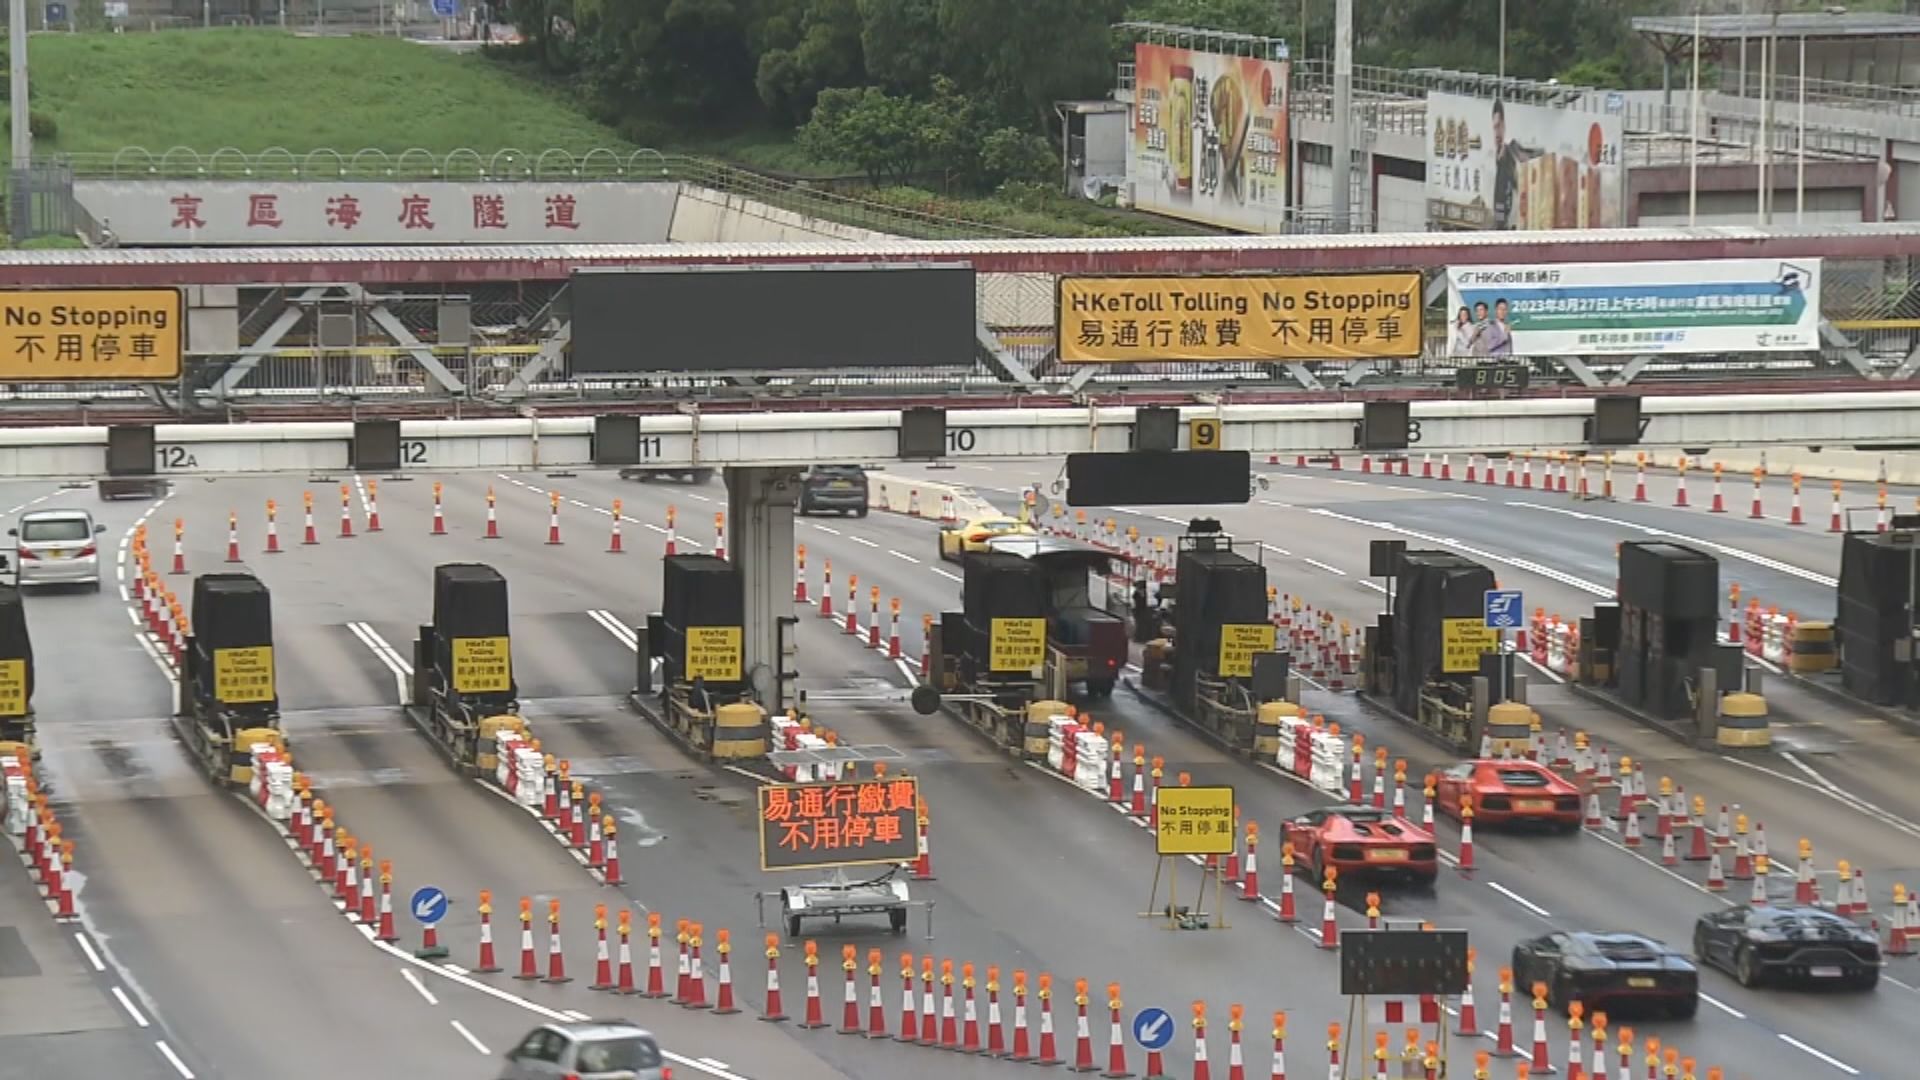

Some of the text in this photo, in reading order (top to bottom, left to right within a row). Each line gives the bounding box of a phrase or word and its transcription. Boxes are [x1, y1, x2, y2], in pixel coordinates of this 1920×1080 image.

[170, 193, 580, 229] 東區海底隧道
[1475, 272, 1523, 283] HKeToll
[1072, 290, 1411, 314] HKeToll Tolling No Stopping
[5, 305, 167, 330] No Stopping
[1077, 316, 1402, 348] 易通行繳費 不用停車
[14, 333, 159, 363] 不用停車
[946, 429, 976, 452] 10
[1197, 424, 1215, 446] 9
[157, 447, 198, 470] 12A
[401, 442, 427, 464] 12
[640, 438, 661, 460] 11
[765, 781, 914, 821] 易通行繳費
[1160, 806, 1230, 817] No Stopping
[779, 814, 902, 850] 不用停車
[1161, 820, 1230, 835] 不用停車
